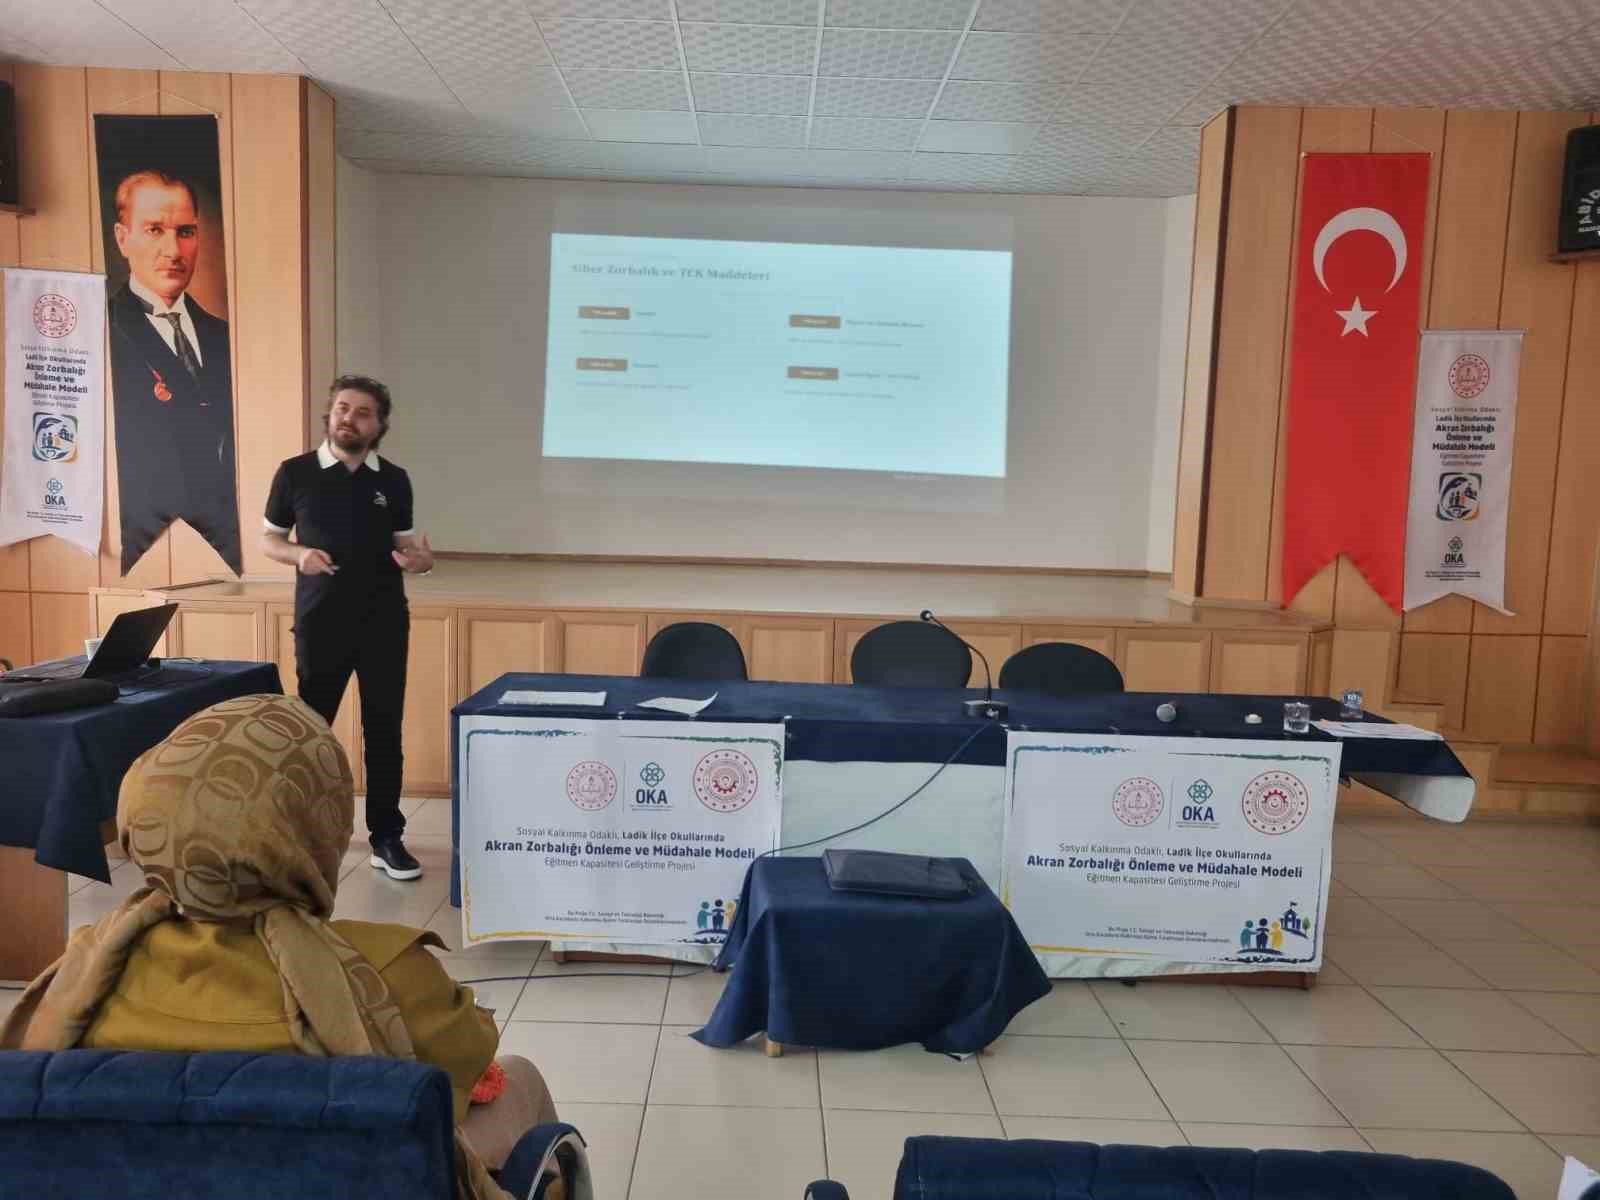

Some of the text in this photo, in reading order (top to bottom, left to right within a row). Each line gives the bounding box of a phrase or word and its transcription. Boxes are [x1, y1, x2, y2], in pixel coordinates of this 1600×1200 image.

[45, 494, 66, 506] OKA
[1444, 552, 1465, 563] OKA
[635, 788, 668, 805] OKA
[1181, 805, 1214, 822] OKA
[516, 826, 545, 839] Sosyal
[622, 830, 648, 840] Ladik
[670, 831, 726, 842] Okullarında
[484, 840, 756, 859] Akran Zorbalığı Önleme ve Müdahale Modeli
[1059, 842, 1088, 854] Sosyal
[1167, 847, 1192, 857] Ladik
[1195, 845, 1212, 859] İlçe
[1215, 849, 1272, 861] Okullarında
[1027, 855, 1303, 878] Akran Zorbalığı Önleme ve Müdahale Modeli
[1212, 878, 1241, 890] Projesi
